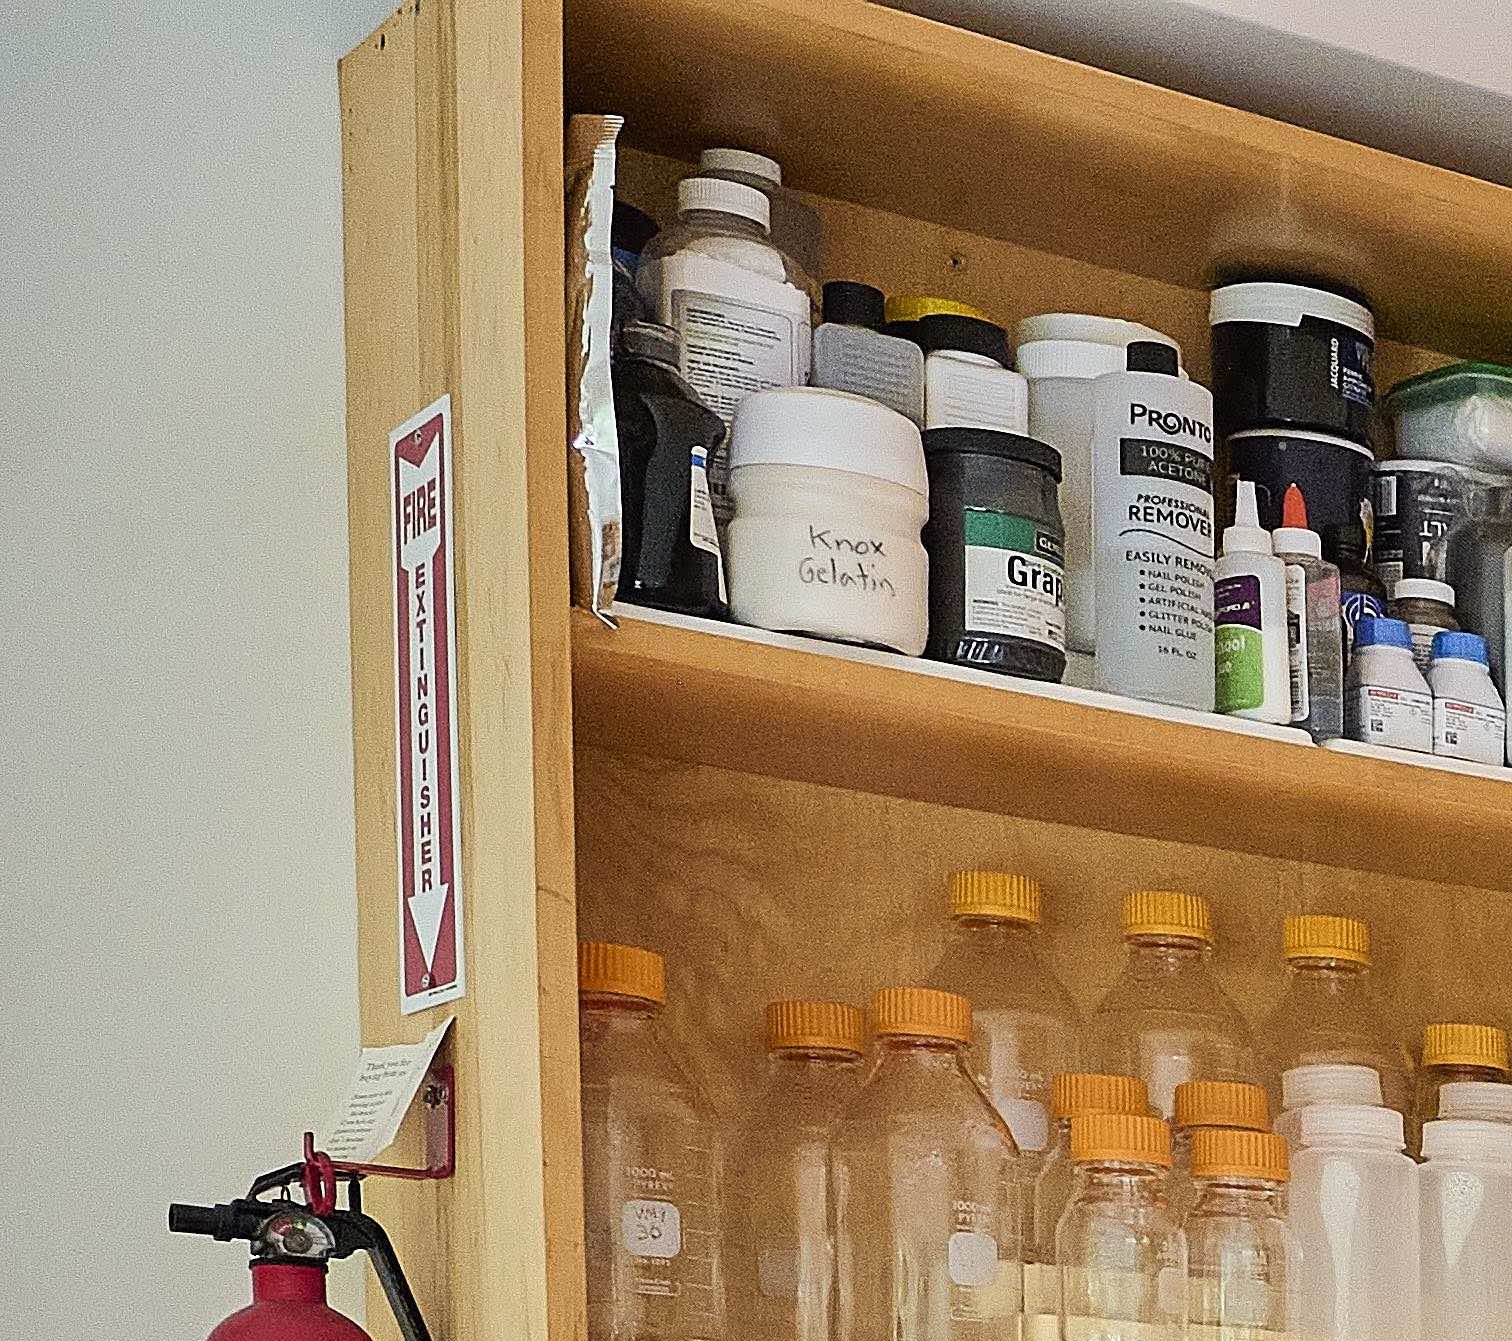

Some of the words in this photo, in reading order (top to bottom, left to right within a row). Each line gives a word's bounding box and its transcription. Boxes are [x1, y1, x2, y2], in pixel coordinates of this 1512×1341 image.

[1130, 403, 1212, 444] PRONTO
[1141, 445, 1182, 463] 100%
[1148, 461, 1208, 487] ACETONE
[403, 483, 438, 545] FIRE
[809, 525, 886, 556] Knox
[1126, 550, 1172, 566] EASILY
[799, 556, 896, 597] Gelatin
[1148, 569, 1172, 581] NAIL
[413, 560, 433, 893] EXTINGUISHER
